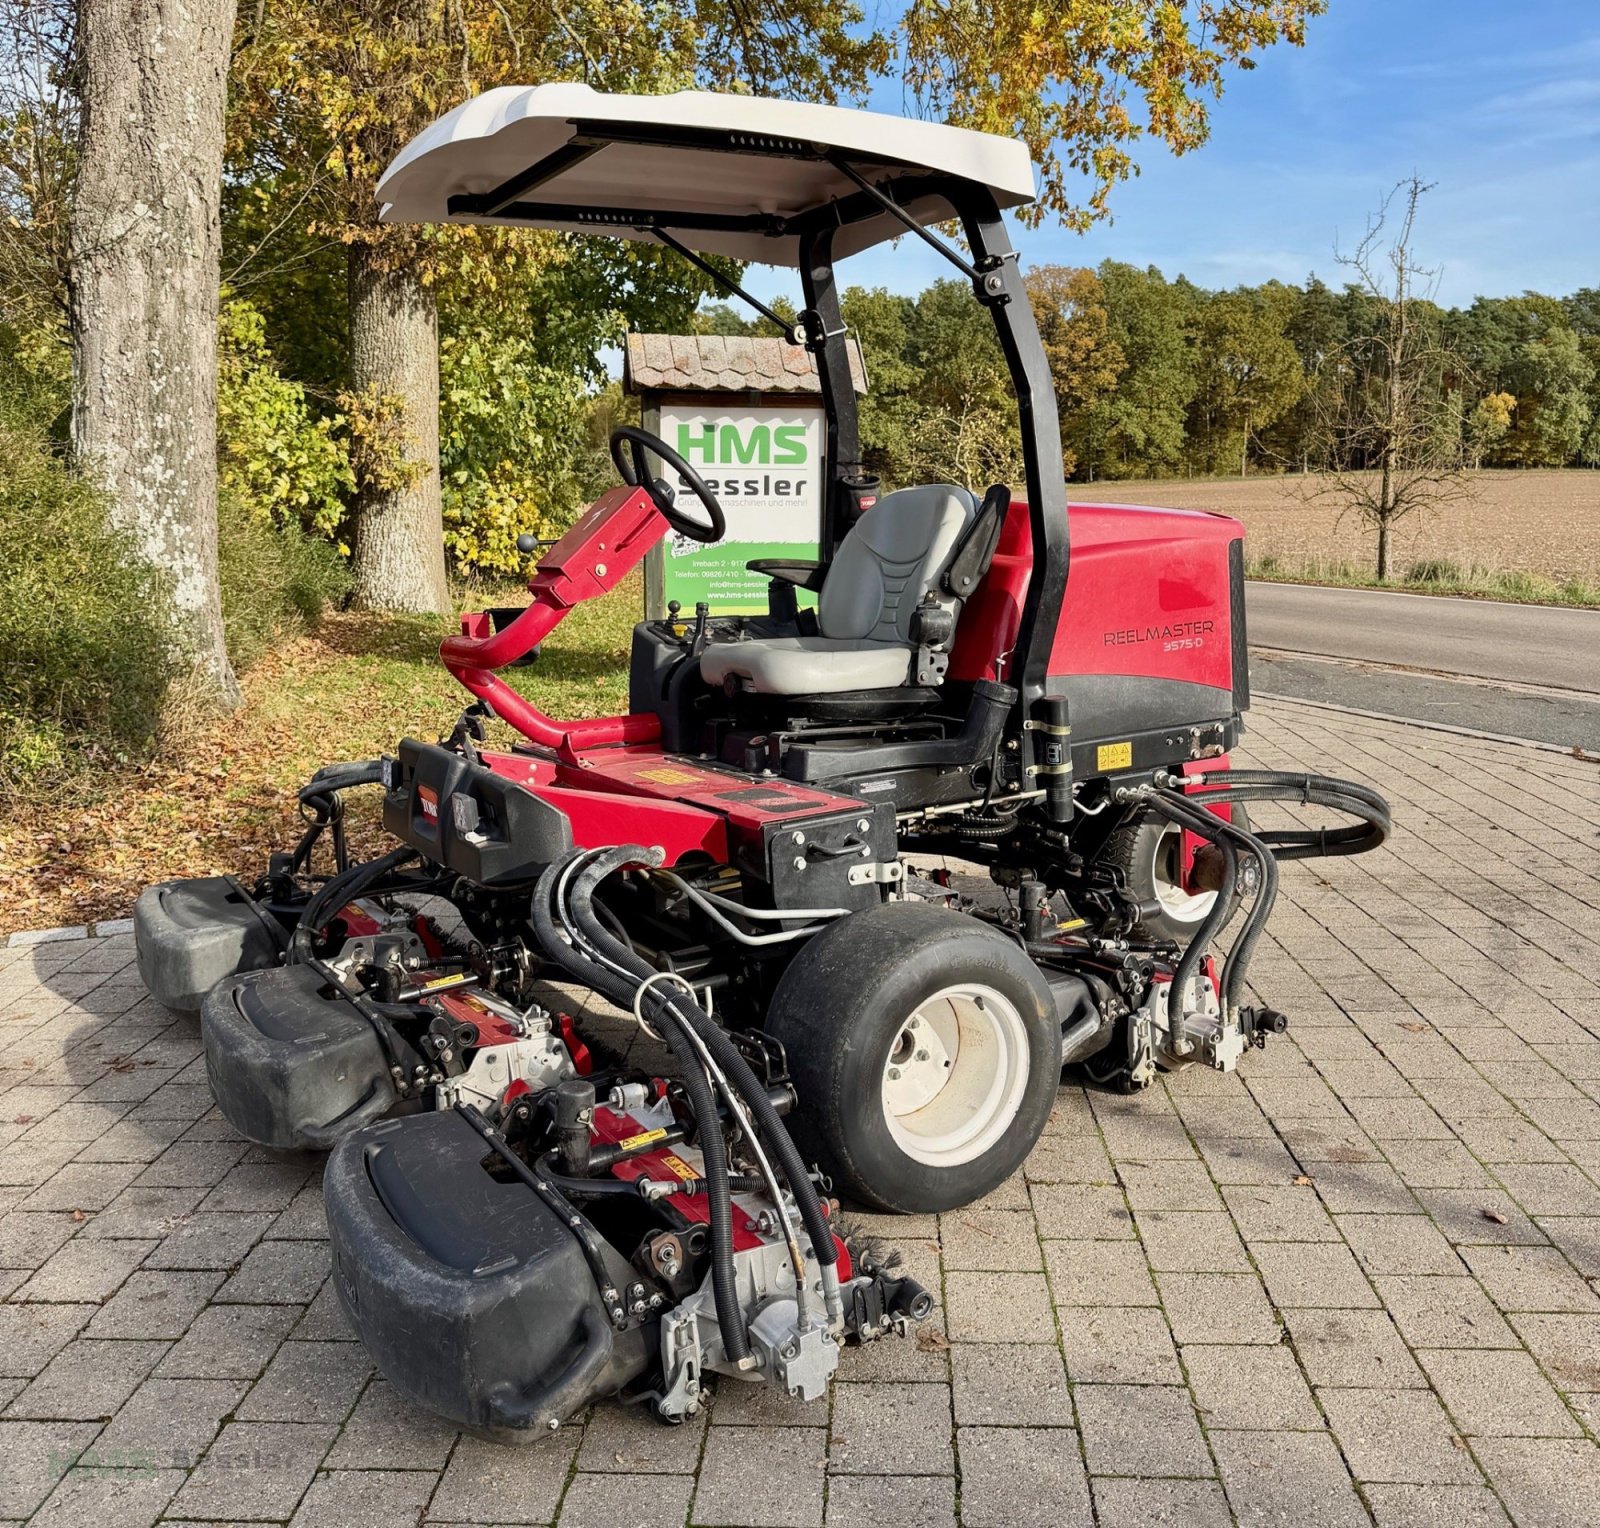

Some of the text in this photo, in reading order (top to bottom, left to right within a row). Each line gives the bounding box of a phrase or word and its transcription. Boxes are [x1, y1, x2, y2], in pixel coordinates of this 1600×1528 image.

[677, 424, 808, 464] HMS
[678, 475, 808, 496] Sessler
[1103, 620, 1214, 647] REELMASTER
